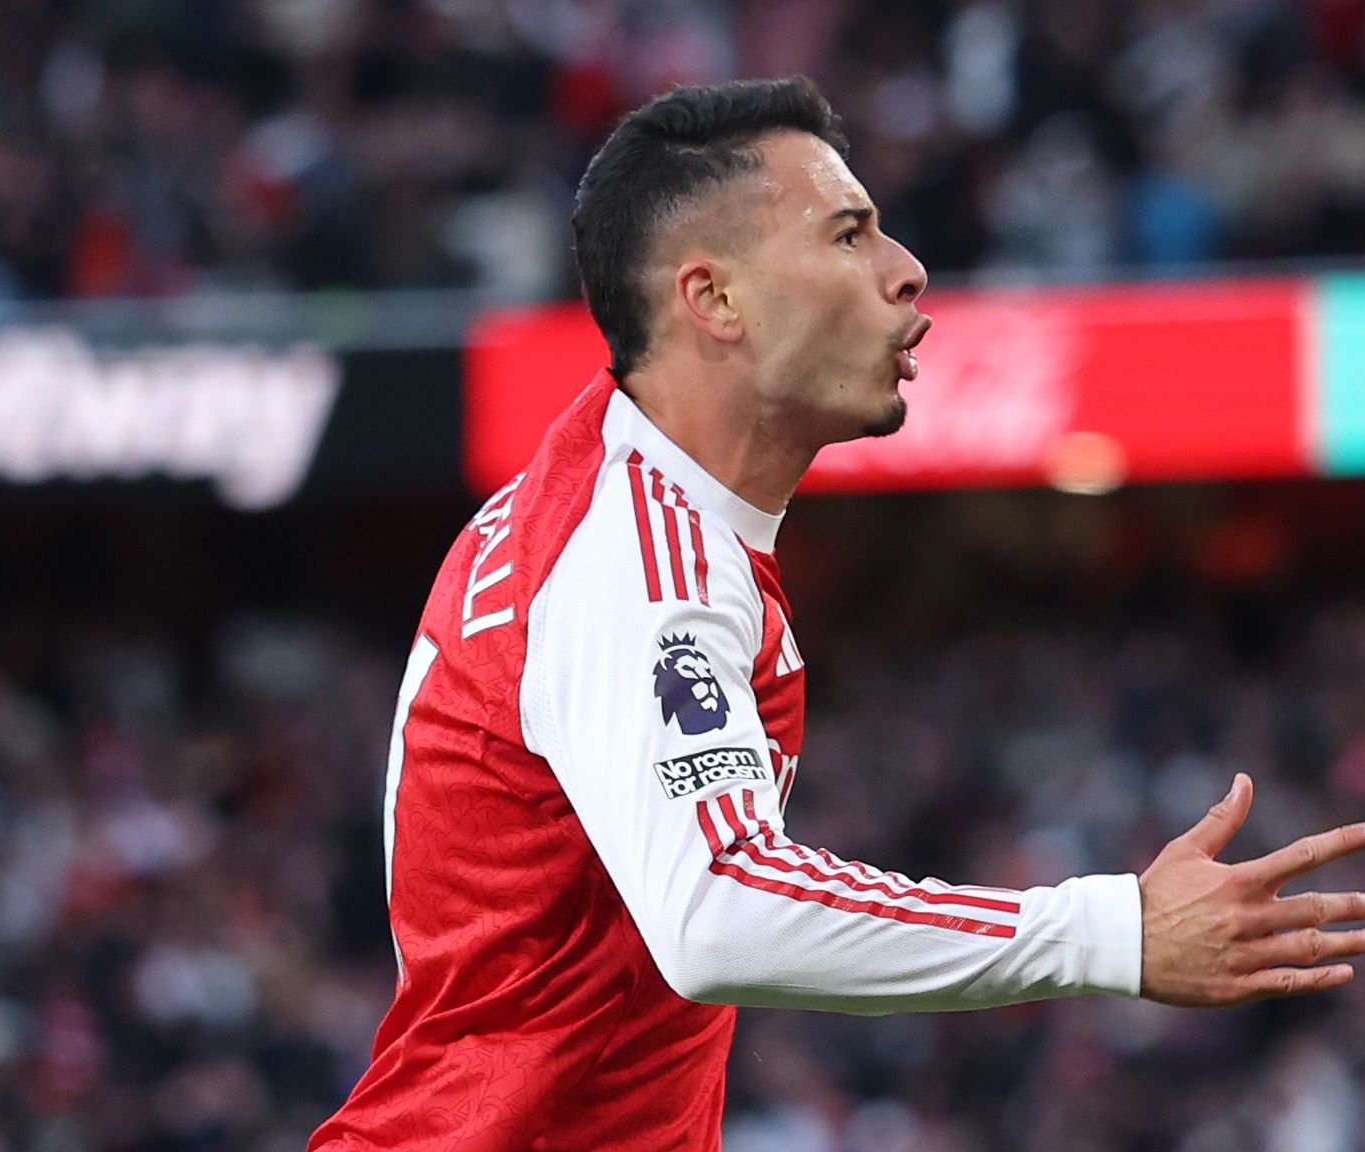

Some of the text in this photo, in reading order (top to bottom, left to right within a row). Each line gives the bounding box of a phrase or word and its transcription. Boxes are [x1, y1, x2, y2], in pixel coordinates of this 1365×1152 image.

[654, 750, 755, 782] No room
[663, 765, 768, 799] for racism
